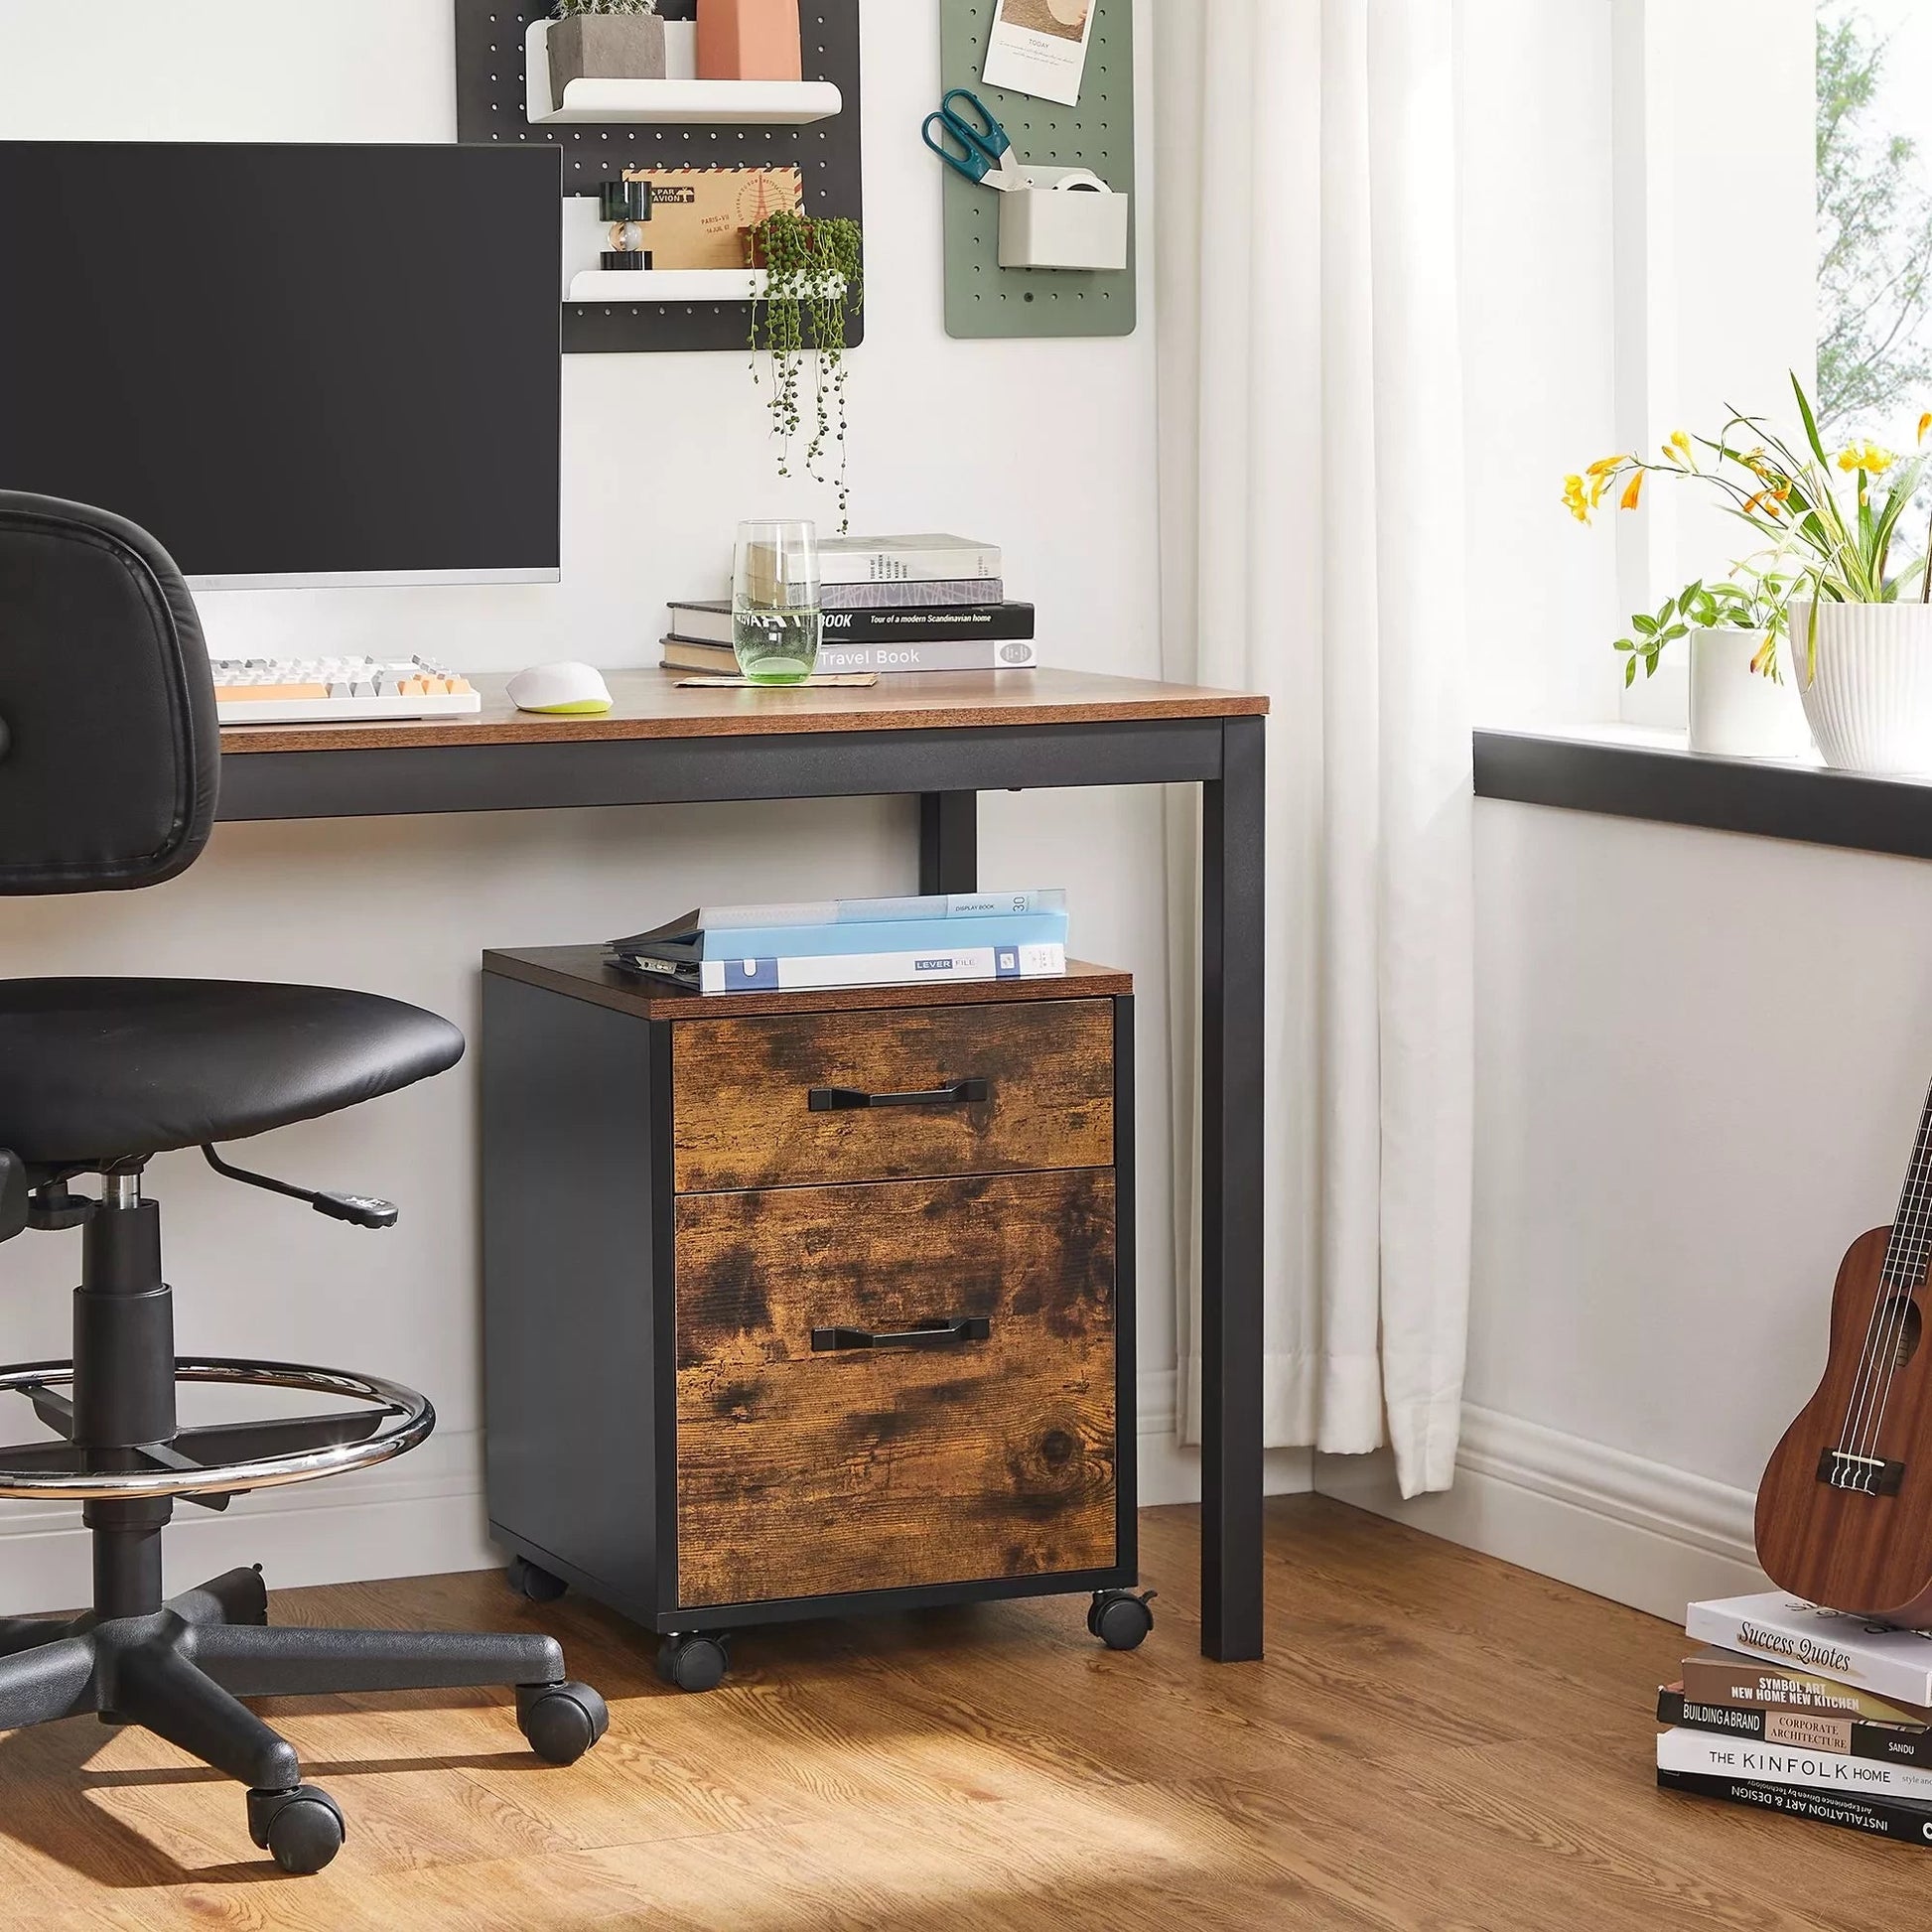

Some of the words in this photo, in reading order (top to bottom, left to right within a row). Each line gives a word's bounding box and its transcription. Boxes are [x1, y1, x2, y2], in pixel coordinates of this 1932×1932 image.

[1029, 39, 1049, 49] TODAY
[871, 615, 886, 623] Tour
[887, 614, 895, 623] of
[900, 614, 926, 623] modern
[927, 614, 972, 623] Scandinavian
[972, 614, 992, 622] home
[819, 649, 870, 665] Travel
[877, 648, 920, 664] Book
[1013, 897, 1026, 911] 30
[916, 960, 951, 970] LEVER
[955, 958, 976, 967] FILE
[1738, 1620, 1794, 1656] Success
[1796, 1638, 1851, 1672] Quotes
[1759, 1677, 1803, 1693] SYMBOL
[1805, 1683, 1827, 1696] ART
[1731, 1686, 1753, 1700] NEW
[1756, 1689, 1787, 1704] HOME
[1789, 1692, 1812, 1706] NEW
[1814, 1695, 1860, 1710] KITCHEN
[1779, 1717, 1839, 1735] CORPORATE
[1770, 1728, 1848, 1749] ARCHITECTURE
[1888, 1741, 1915, 1755] SANDU
[1710, 1750, 1735, 1765] THE
[1742, 1753, 1849, 1780] KINFOLK
[1853, 1767, 1891, 1783] HOME
[1902, 1775, 1920, 1785] style
[1731, 1785, 1772, 1804] DESIGN
[1747, 1780, 1787, 1796] Technology
[1787, 1788, 1797, 1798] by
[1774, 1795, 1783, 1807] &
[1797, 1791, 1821, 1803] Driven
[1821, 1797, 1860, 1812] Experience
[1786, 1798, 1807, 1812] ART
[1808, 1803, 1888, 1832] INSTALLATION
